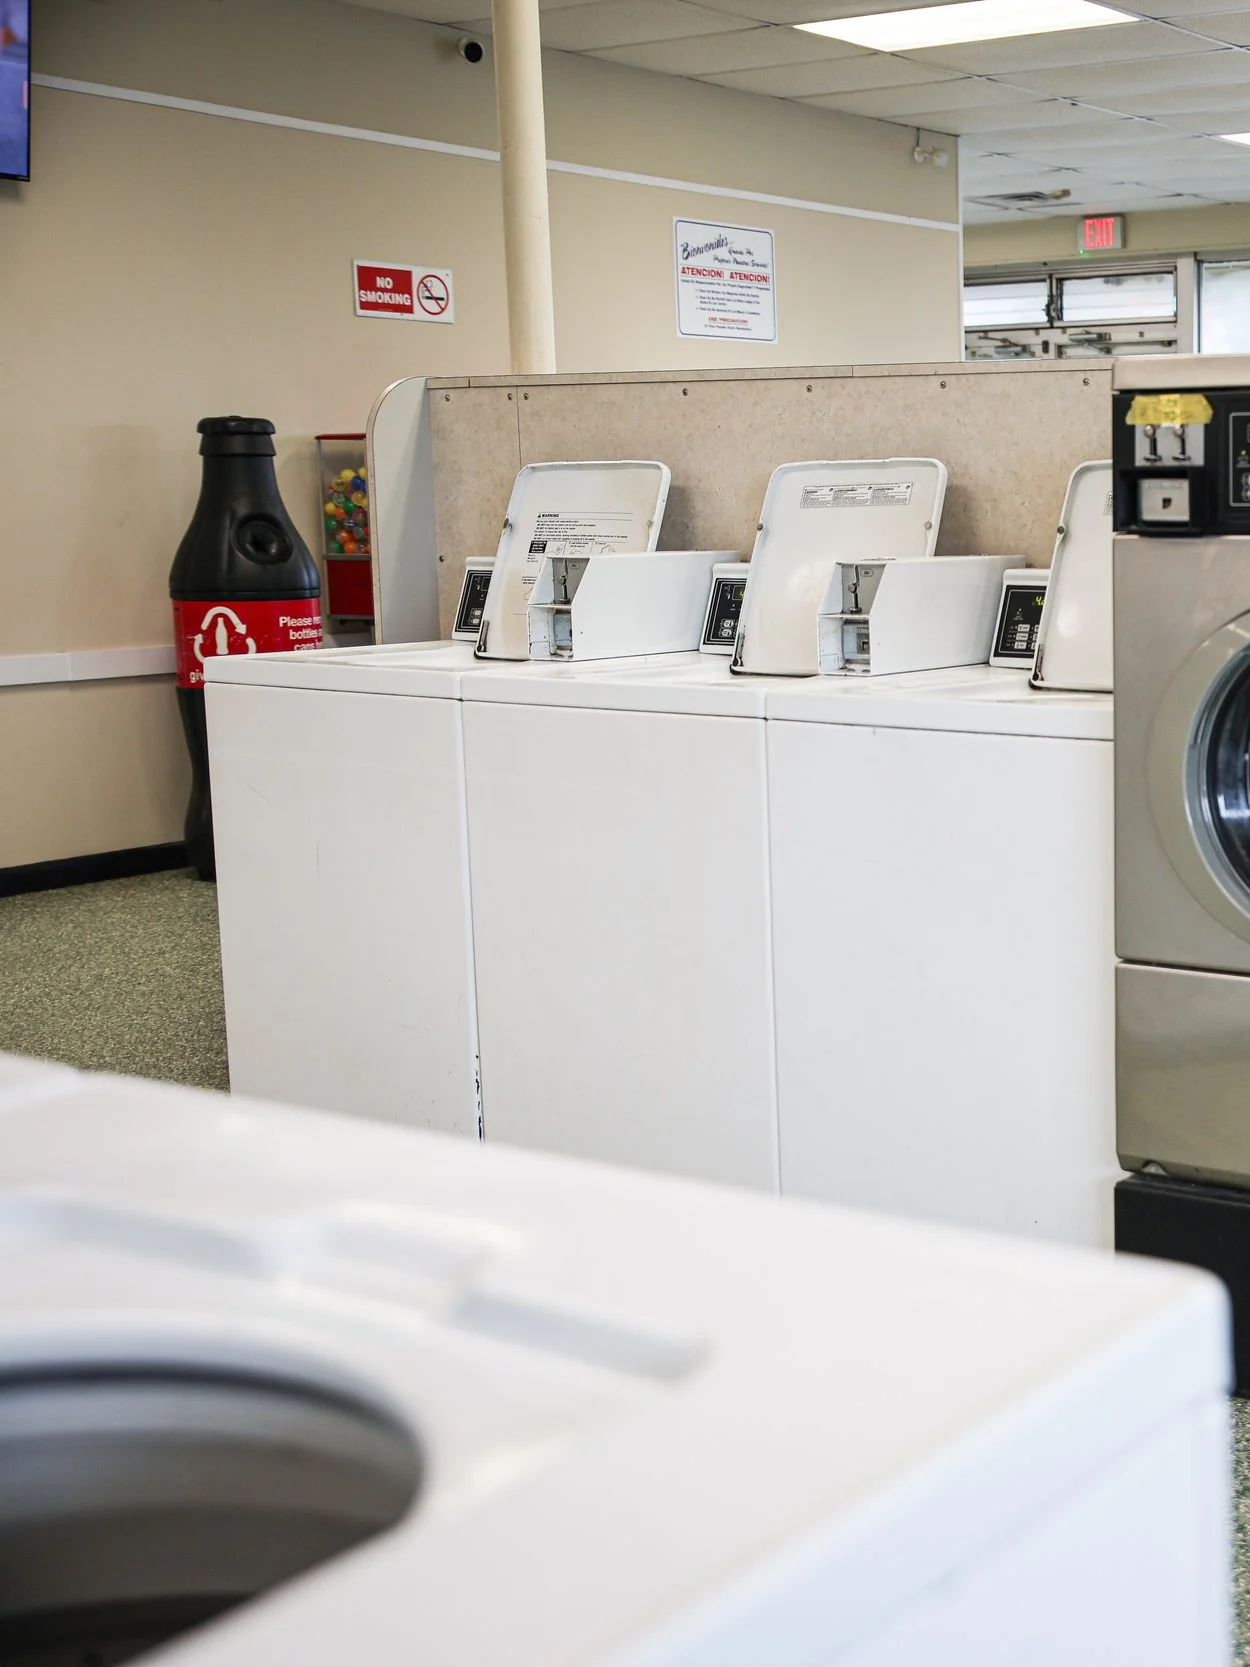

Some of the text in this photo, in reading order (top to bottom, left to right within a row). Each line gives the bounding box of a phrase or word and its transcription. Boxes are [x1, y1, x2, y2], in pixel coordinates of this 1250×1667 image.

[1084, 217, 1114, 248] EXIT
[681, 266, 770, 284] ATENCION! ATENCION!
[375, 276, 394, 289] NO
[360, 290, 412, 306] SMOKING
[279, 616, 313, 627] Please
[290, 628, 318, 640] bottles
